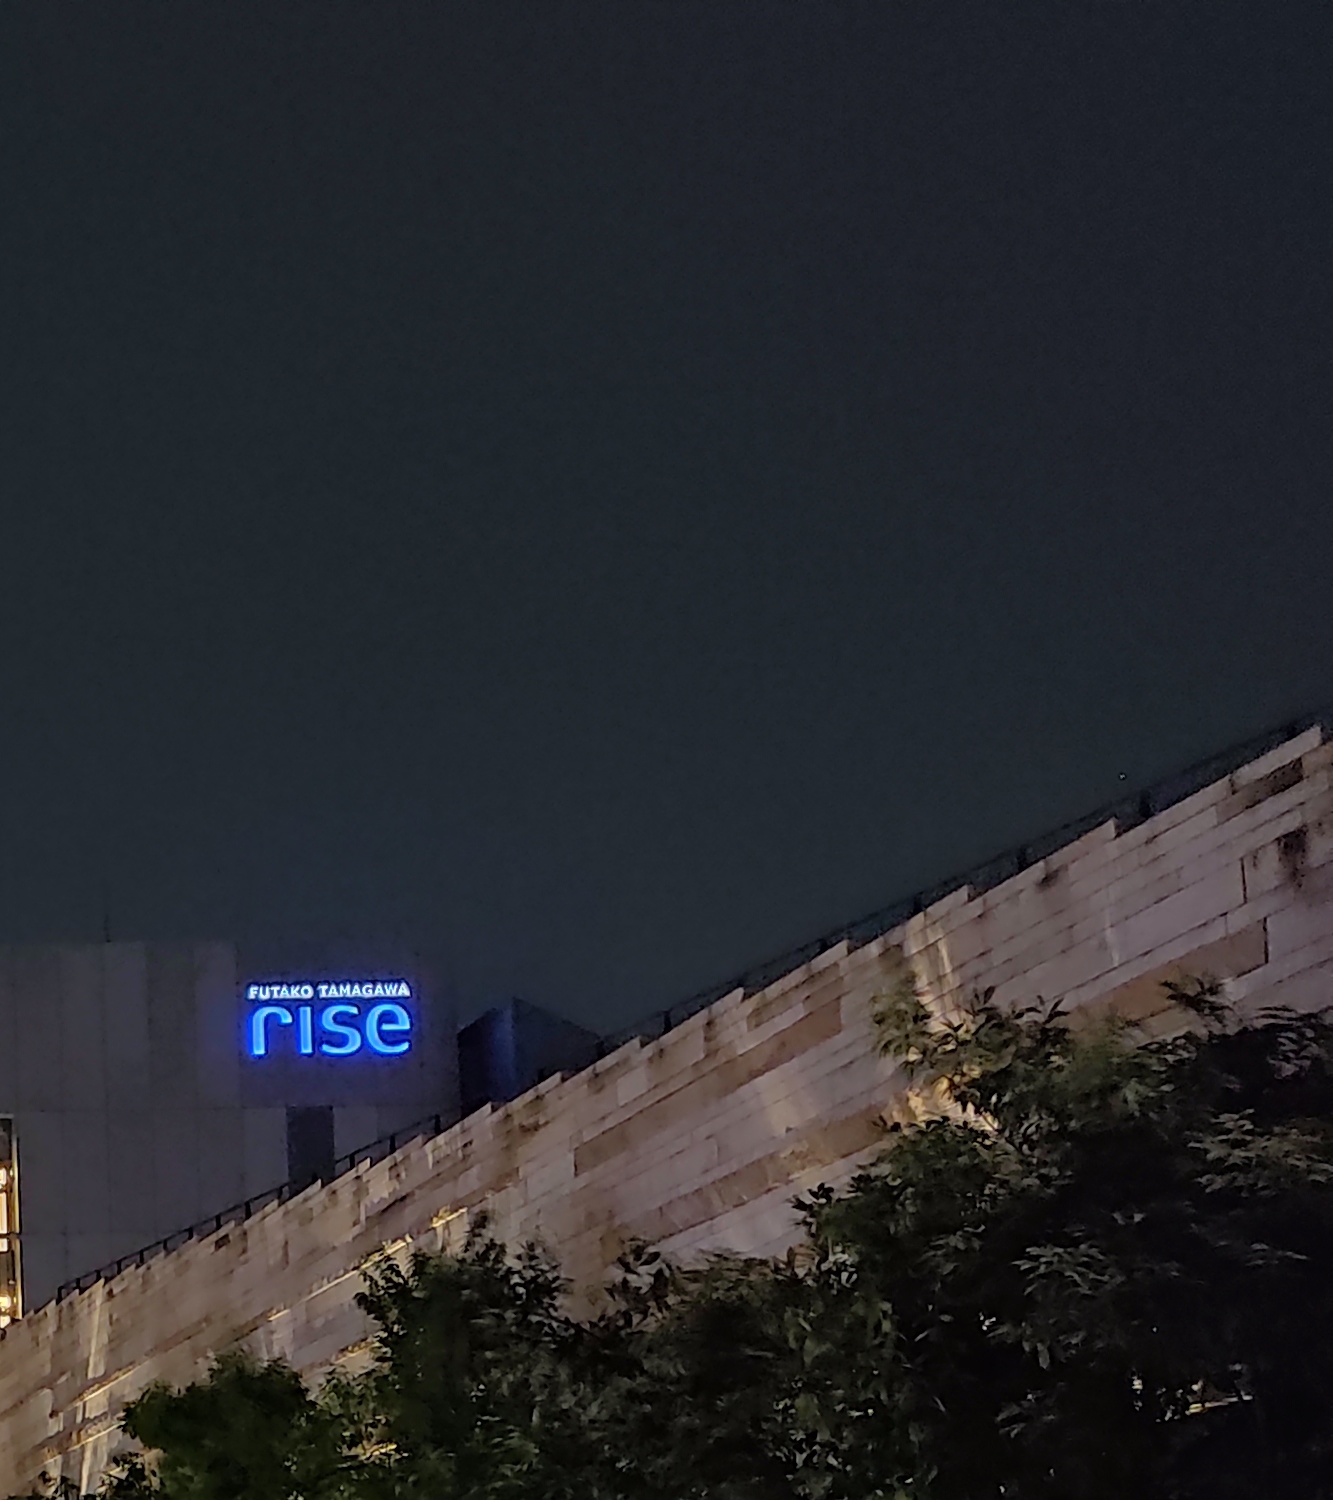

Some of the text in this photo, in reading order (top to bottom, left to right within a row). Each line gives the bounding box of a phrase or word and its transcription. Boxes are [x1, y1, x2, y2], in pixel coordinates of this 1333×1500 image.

[247, 980, 410, 1000] FUTAKO TAMAGAWA
[251, 1003, 411, 1056] rise
